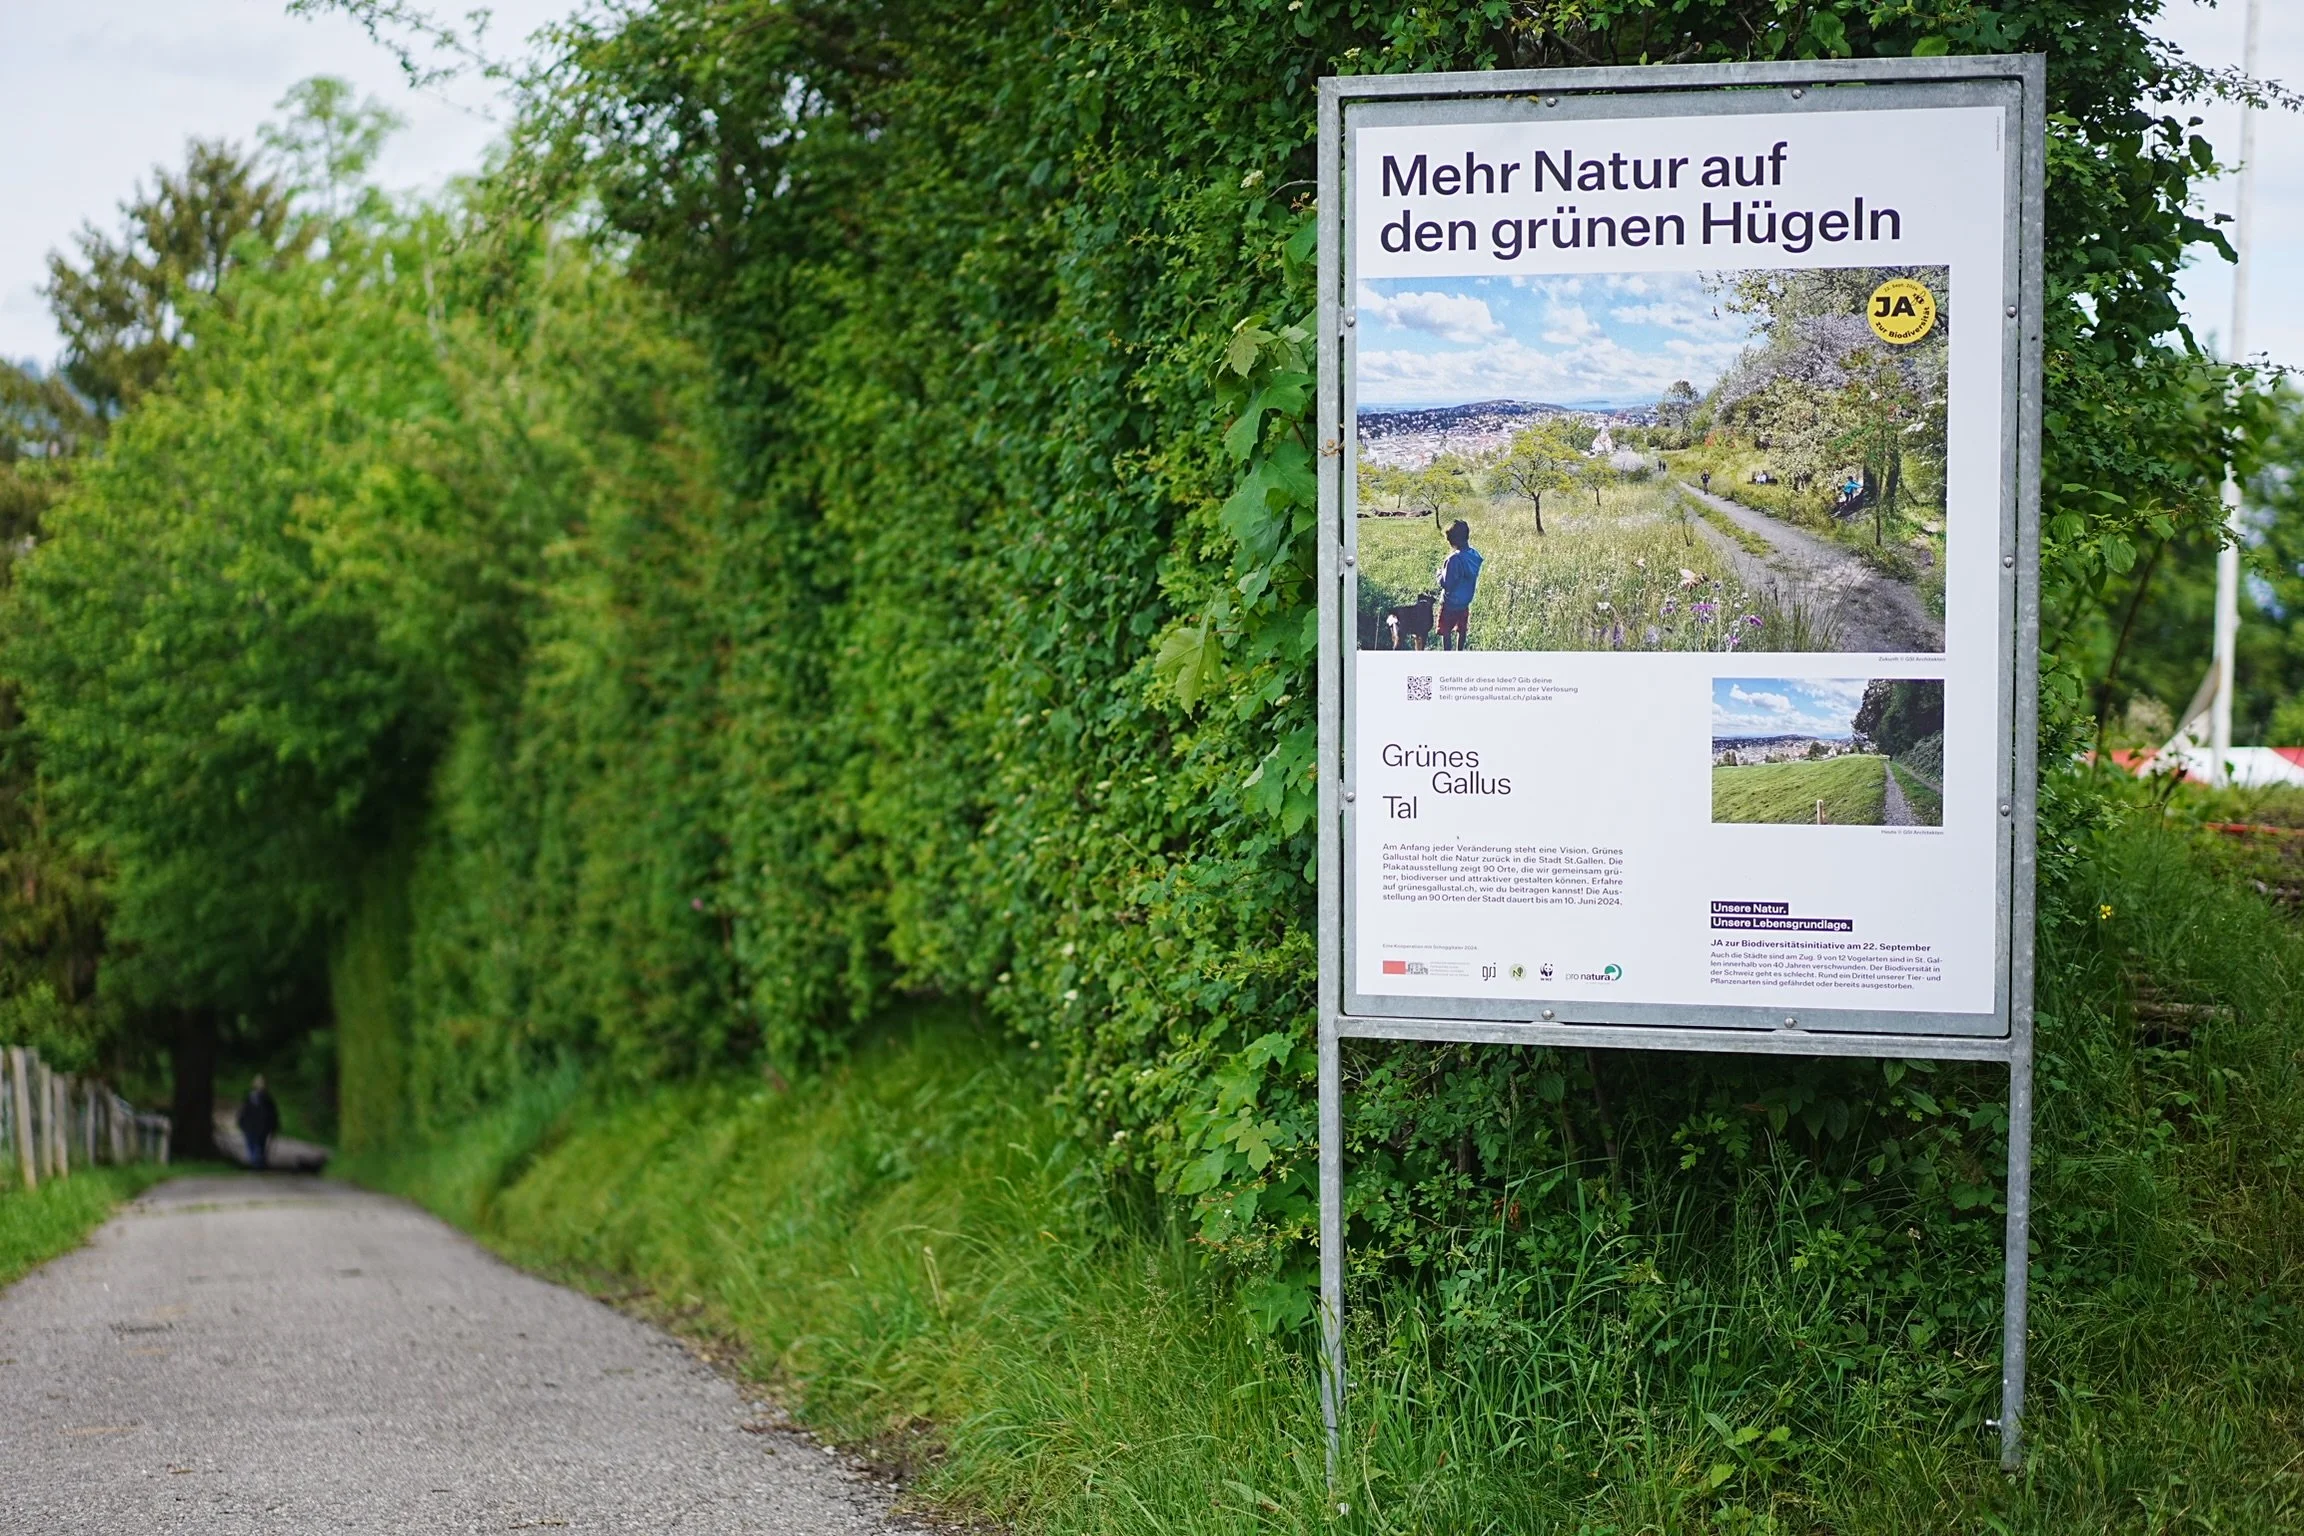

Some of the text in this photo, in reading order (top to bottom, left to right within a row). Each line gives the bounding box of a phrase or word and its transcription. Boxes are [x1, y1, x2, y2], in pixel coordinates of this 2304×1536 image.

[1381, 142, 1788, 198] Mehr Natur auf
[1381, 197, 1901, 260] den grünen Hügeln
[1874, 296, 1915, 317] JA
[1876, 307, 1929, 338] zur Biodiversität
[1541, 686, 1578, 694] Verlosung
[1454, 694, 1552, 702] grünesgallustal.ch/plakate
[1382, 744, 1479, 768] Grünes
[1432, 772, 1511, 794] Gallus
[1382, 796, 1418, 819] Tal
[1400, 844, 1430, 852] Anfang
[1432, 844, 1454, 852] jeder
[1457, 844, 1512, 854] Veränderung
[1560, 846, 1589, 854] Vision.
[1592, 847, 1623, 855] Grünes
[1383, 864, 1458, 872] Plakatausstellung
[1460, 865, 1480, 873] zeigt
[1496, 866, 1518, 874] Orte,
[1552, 868, 1602, 876] gemeinsam
[1604, 868, 1622, 876] grü-
[1401, 874, 1447, 882] biodiverser
[1468, 875, 1511, 883] attraktiver
[1514, 877, 1553, 885] gestalten
[1398, 884, 1477, 893] grünesgallustal.ch,
[1509, 886, 1549, 894] beitragen
[1383, 893, 1416, 902] stellung
[1506, 896, 1534, 904] dauert
[1713, 903, 1787, 914] Unsere Natur.
[1713, 918, 1851, 931] Unsere Lebensgrundlage.
[1741, 940, 1845, 949] Biodiversitätsinitiative
[1879, 944, 1931, 952] September
[1799, 954, 1816, 962] Zug.
[1847, 955, 1888, 963] Vogelarten
[1812, 963, 1868, 971] verschwunden.
[1779, 979, 1814, 987] gefährdet
[1861, 982, 1914, 990] ausgestorben.
